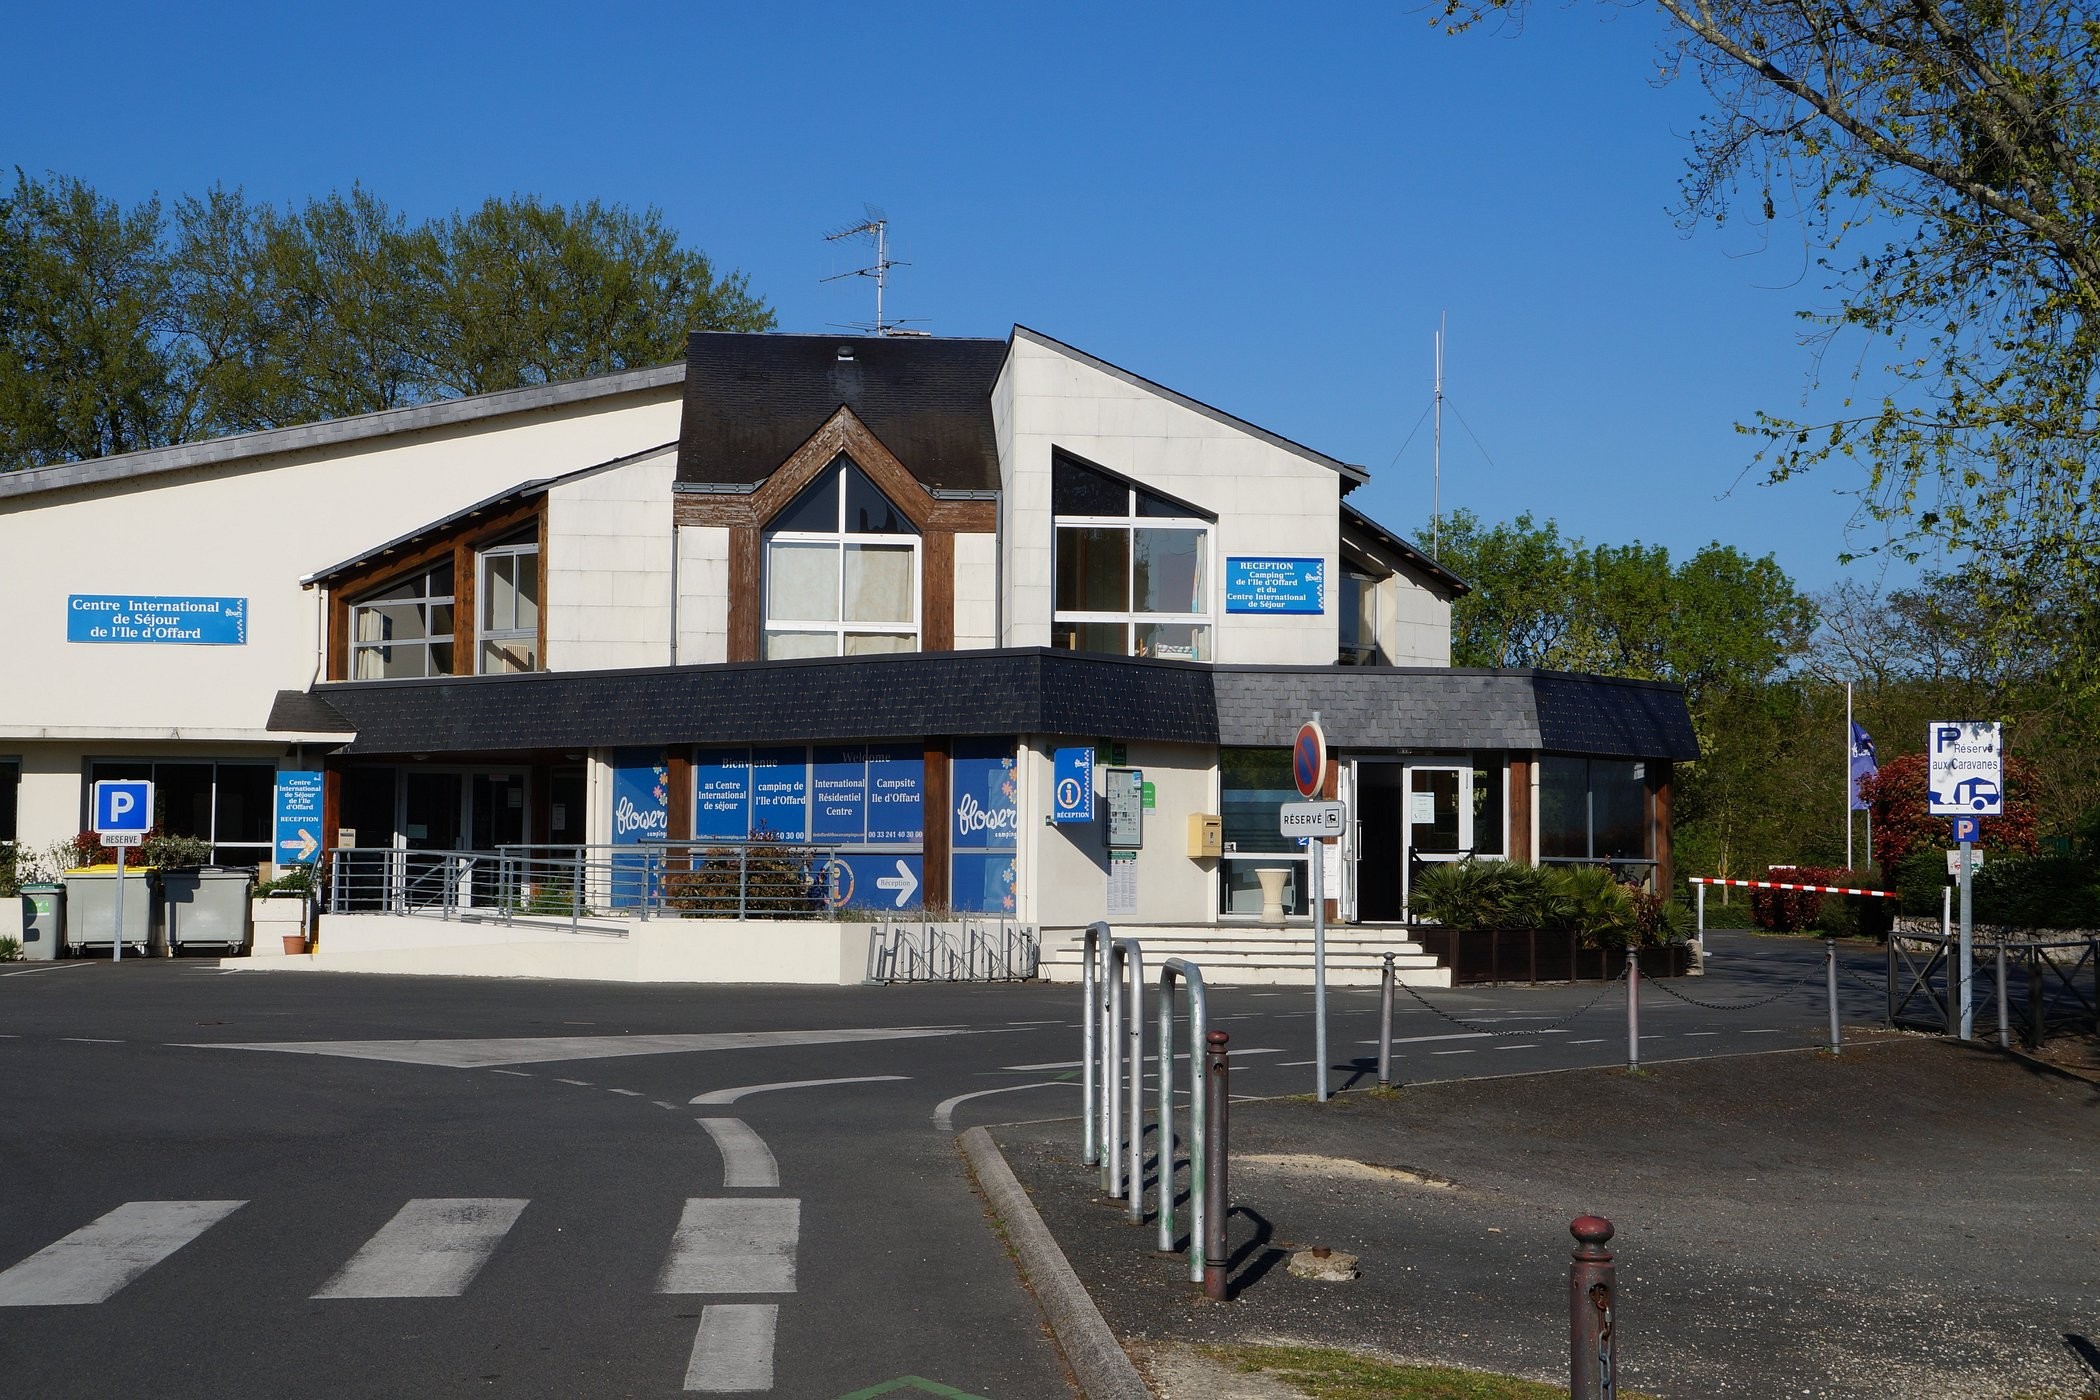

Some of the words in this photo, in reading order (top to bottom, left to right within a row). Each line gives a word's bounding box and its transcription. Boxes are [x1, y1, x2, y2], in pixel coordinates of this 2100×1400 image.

[1240, 562, 1293, 570] RECEPTION
[72, 599, 120, 611] Centre
[128, 600, 220, 613] International
[113, 614, 130, 624] de
[134, 614, 180, 626] Séjour
[90, 627, 107, 637] de
[112, 627, 138, 637] l'Ile
[142, 627, 200, 638] d'Offard
[1938, 728, 1961, 753] P
[722, 758, 778, 768] Bienvenue
[1933, 761, 1948, 769] aux
[1952, 758, 1997, 770] Caravanes
[716, 781, 740, 789] Centre
[758, 782, 792, 792] camping
[794, 781, 804, 790] de
[815, 779, 865, 788] International
[877, 778, 916, 789] Campsite
[698, 791, 746, 799] International
[818, 793, 861, 802] Résidentiel
[872, 794, 882, 802] Ile
[884, 793, 920, 802] d'Offard
[773, 796, 806, 805] d'Offard
[111, 792, 134, 822] P
[715, 802, 738, 812] séjour
[826, 807, 853, 815] Centre
[616, 796, 667, 834] flower
[958, 794, 1017, 835] flower
[1284, 814, 1322, 824] RÉSERVÉ
[1958, 820, 1974, 839] P
[106, 836, 137, 844] RESERVE
